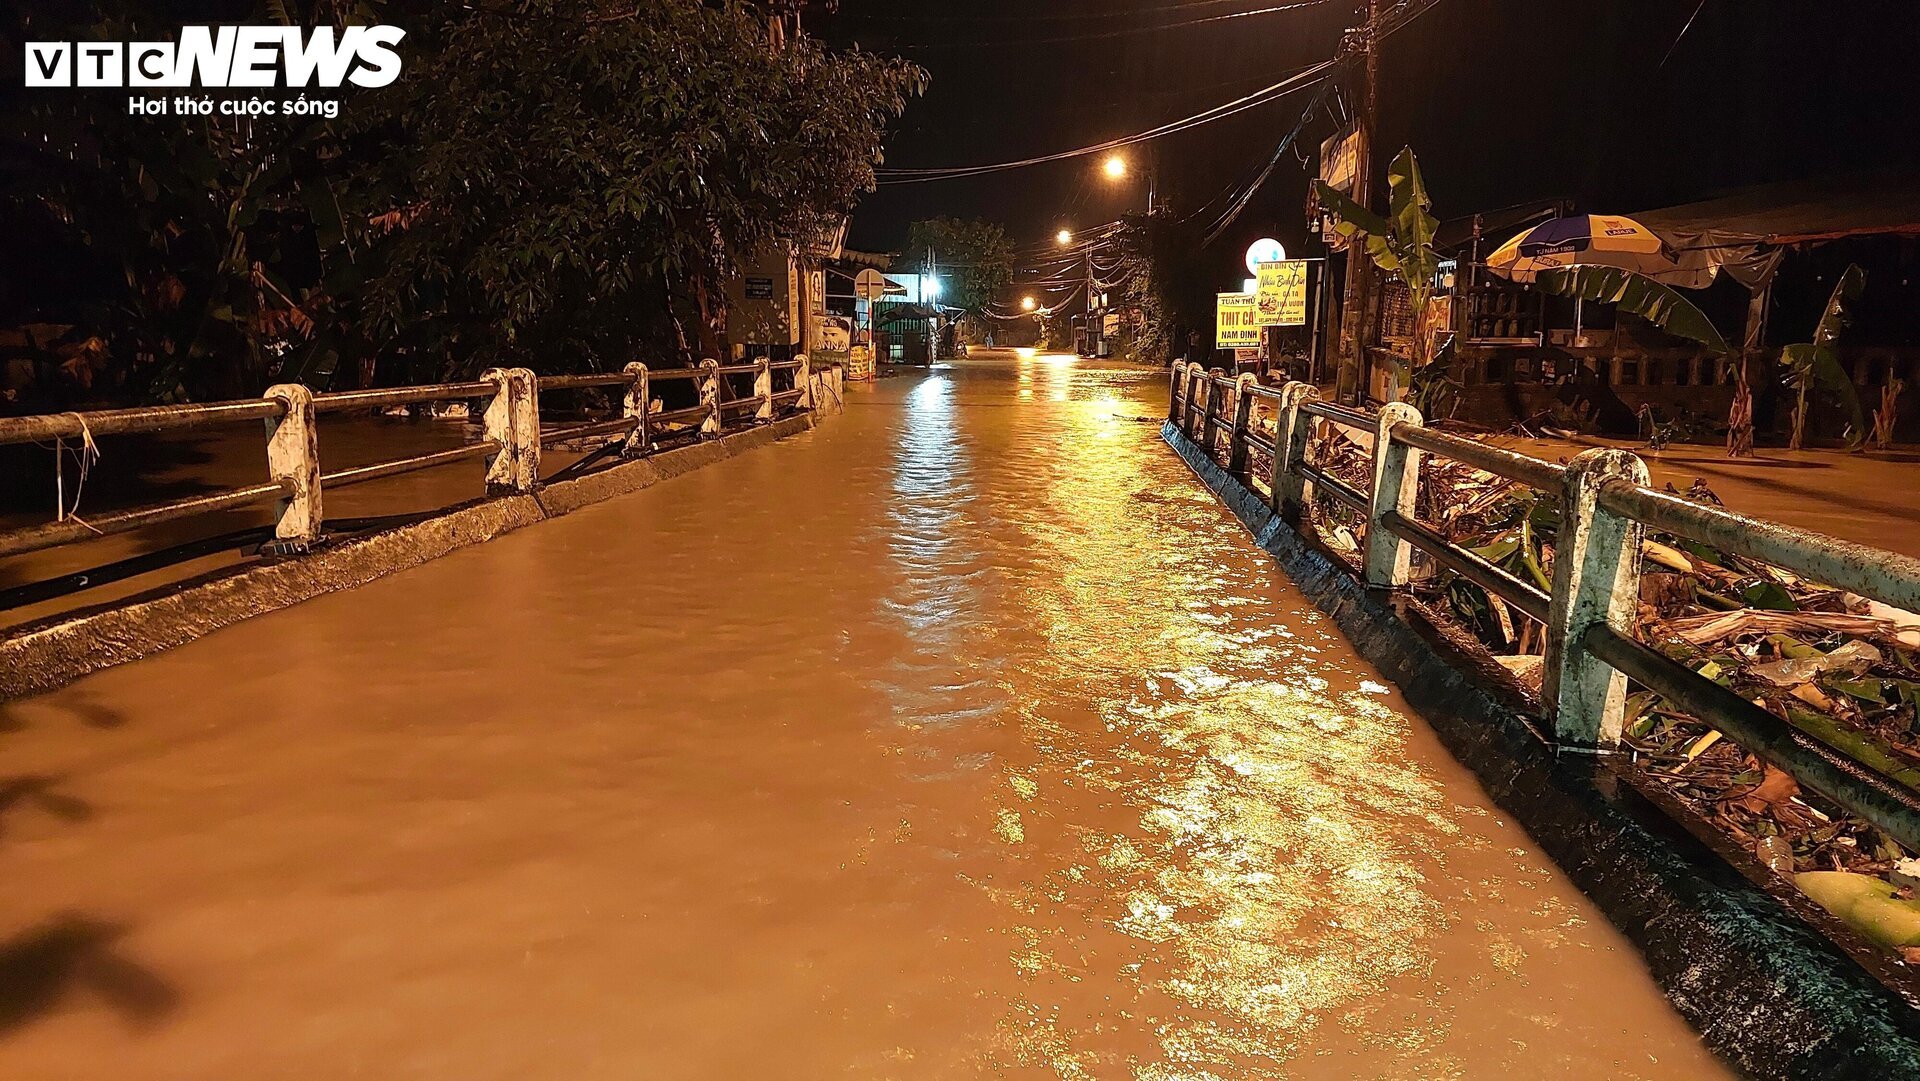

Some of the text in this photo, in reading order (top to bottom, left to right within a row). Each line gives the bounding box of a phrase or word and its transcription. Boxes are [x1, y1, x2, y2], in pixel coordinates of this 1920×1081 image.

[1221, 312, 1240, 328] THỊT
[1221, 330, 1257, 341] NAM ĐỊNH
[815, 339, 847, 350] ANNA
